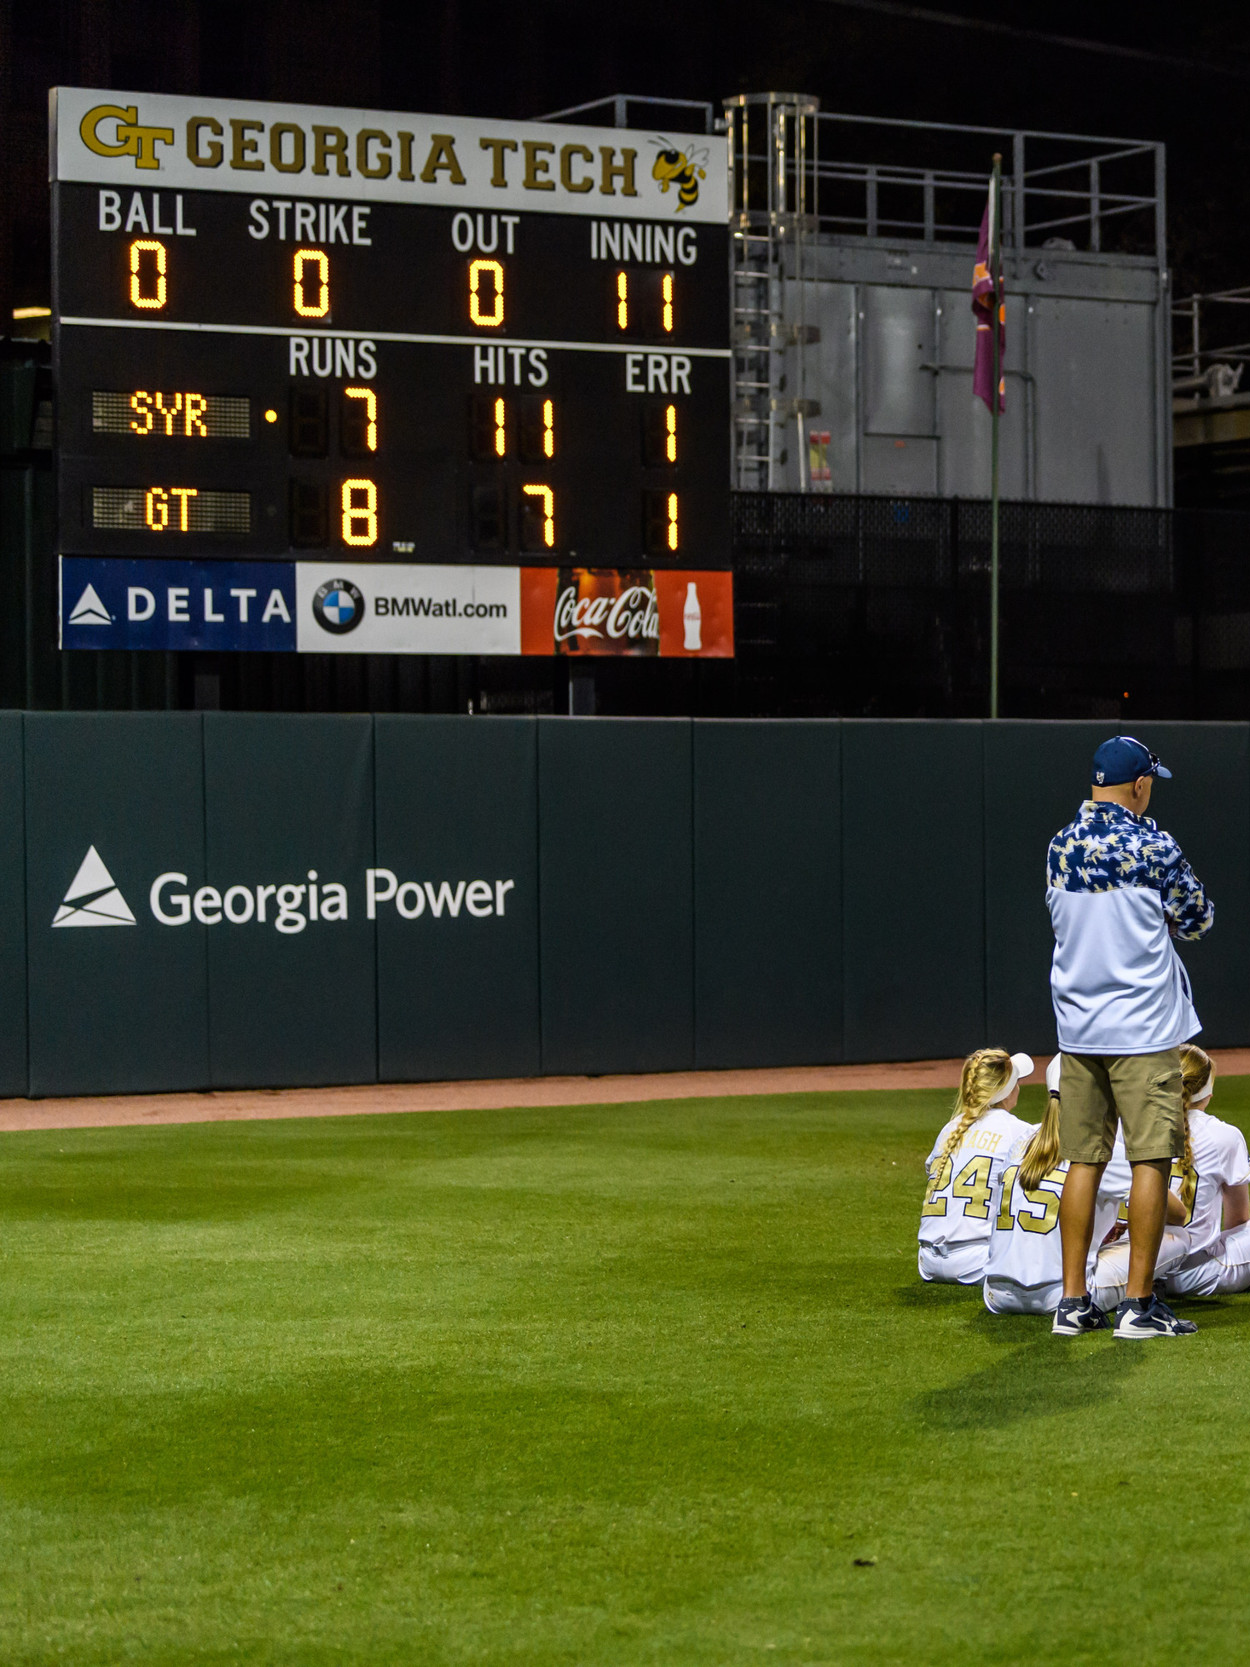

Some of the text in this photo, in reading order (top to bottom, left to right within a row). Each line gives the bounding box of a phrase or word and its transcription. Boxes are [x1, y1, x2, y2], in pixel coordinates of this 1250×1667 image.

[186, 115, 638, 196] GEORGIA TECH
[99, 191, 197, 236] BALL
[248, 200, 373, 246] STRIKE
[452, 213, 521, 254] OUT
[591, 221, 698, 265] INNING
[129, 240, 167, 310] 0
[293, 249, 330, 318] 0
[469, 259, 505, 327] 0
[617, 272, 674, 332] 11
[289, 338, 378, 379] RUNS
[474, 347, 549, 387] HITS
[626, 354, 692, 395] ERR
[130, 391, 208, 437] SYR
[345, 387, 378, 452] 7
[494, 397, 554, 458] 11
[666, 404, 677, 463] 1
[145, 488, 198, 532] GT
[341, 478, 378, 547] 8
[522, 485, 555, 548] 7
[667, 492, 678, 551] 1
[128, 587, 291, 623] DELTA
[374, 597, 507, 618] BMWatl.com
[150, 868, 515, 934] Georgia Power
